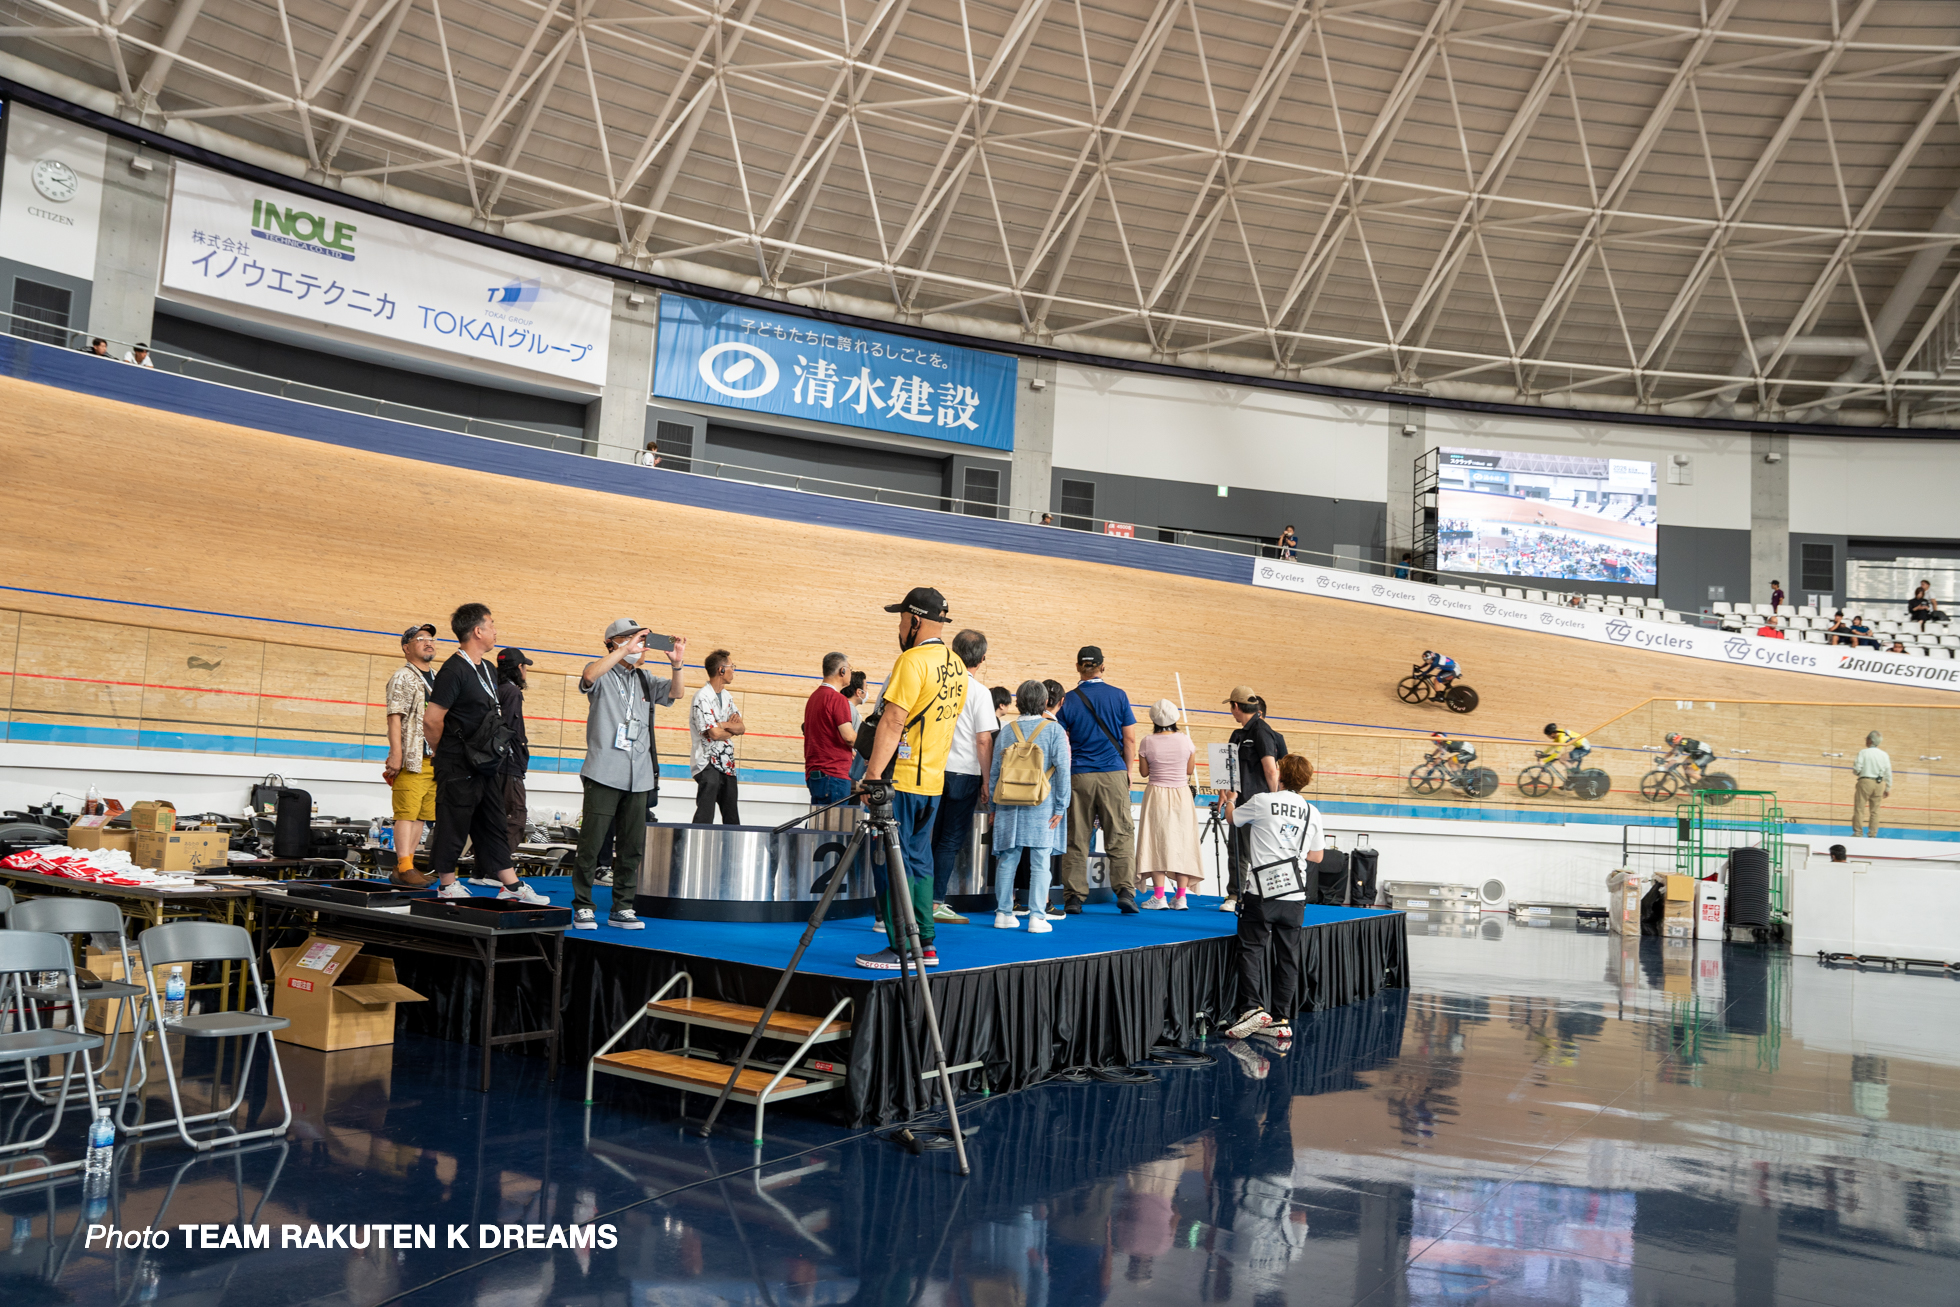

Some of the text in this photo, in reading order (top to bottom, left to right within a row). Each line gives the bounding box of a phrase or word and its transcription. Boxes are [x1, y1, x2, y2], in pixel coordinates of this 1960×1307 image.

[27, 206, 75, 226] CITIZEN
[251, 199, 357, 254] INOUE
[191, 229, 250, 257] 株式会社
[264, 233, 308, 250] TECHNICA
[326, 248, 343, 259] LTD
[191, 250, 396, 320] イノウエテクニカ
[484, 310, 534, 327] TOKAI GROUP
[418, 305, 593, 362] TOKAIグループ
[741, 318, 949, 370] 子どもたちに誇れるしごとを。
[792, 354, 981, 431] 清水建設
[1275, 572, 1305, 583] Cyclers
[1331, 581, 1360, 592] Cyclers
[1386, 589, 1416, 601] Cyclers
[1442, 599, 1472, 611] Cyclers
[1498, 608, 1528, 620] Cyclers
[1555, 618, 1585, 629] Cyclers
[1635, 630, 1694, 650] Cyclers
[1755, 647, 1817, 667] Cyclers
[1838, 656, 1960, 682] BRIDGESTONE
[938, 681, 963, 701] Girls
[1271, 802, 1307, 821] CREW
[188, 850, 202, 866] 水
[810, 842, 848, 894] 2
[1092, 861, 1105, 884] 3
